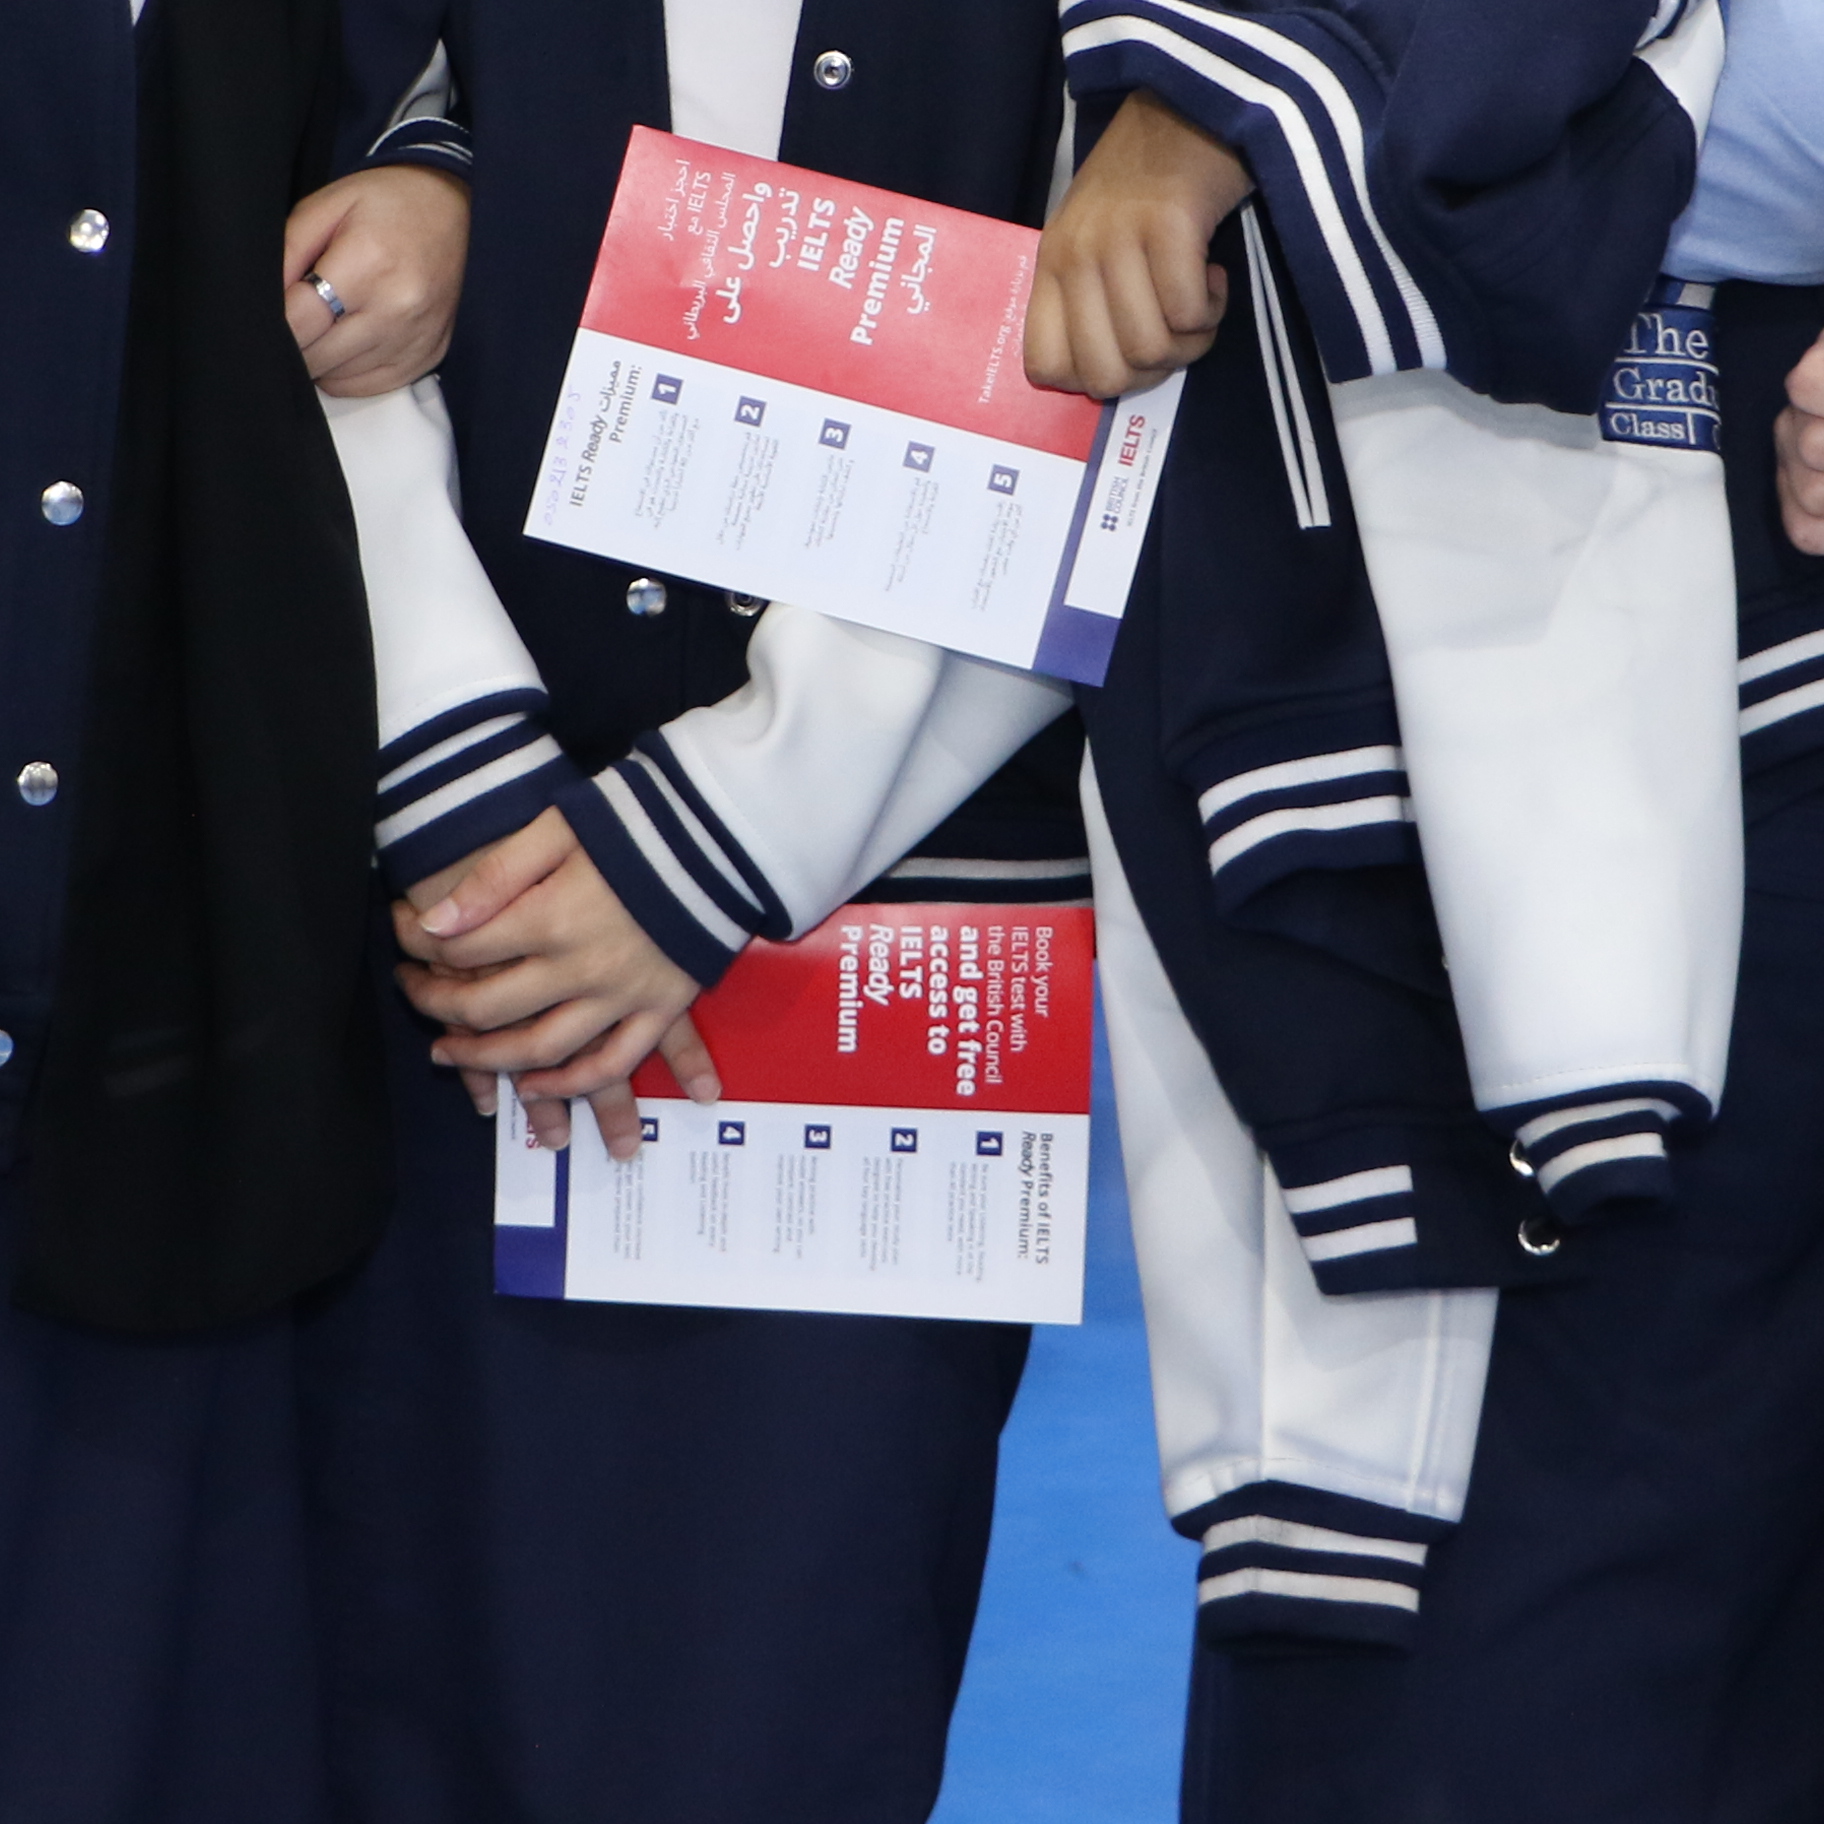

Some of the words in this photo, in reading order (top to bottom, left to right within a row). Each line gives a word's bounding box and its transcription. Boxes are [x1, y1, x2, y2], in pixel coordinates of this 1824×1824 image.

[669, 158, 691, 197] احجز
[686, 170, 711, 212] IELTS
[714, 171, 736, 228] المجلس
[656, 196, 679, 240] اختبار
[686, 215, 703, 235] مع
[727, 181, 772, 270] واحصل
[768, 186, 800, 268] تدريب
[796, 197, 835, 271] IELTS
[827, 205, 874, 289] Ready
[899, 223, 936, 314] المجاني
[715, 276, 741, 324] على
[849, 217, 904, 345] Premium
[1624, 312, 1709, 360] The
[608, 364, 642, 443] Premium:
[1609, 412, 1686, 440] Class
[568, 464, 592, 507] IELTS
[580, 413, 608, 463] Ready
[1117, 414, 1145, 467] IELTS
[1104, 475, 1120, 512] BRITISH
[1113, 477, 1129, 514] COUNCIL
[862, 923, 896, 1005] Ready
[898, 926, 924, 998] IELTS
[958, 925, 984, 979] and
[987, 925, 1005, 954] the
[1010, 926, 1028, 972] IELTS
[1034, 926, 1053, 971] Book
[837, 925, 865, 1052] Premium
[927, 925, 950, 1017] access
[986, 960, 1005, 1014] British
[1010, 977, 1027, 1009] test
[1028, 975, 1048, 1016] your
[951, 985, 980, 1032] get
[1009, 1013, 1027, 1051] with
[927, 1024, 949, 1054] to
[984, 1019, 1004, 1083] Council
[956, 1039, 982, 1095] free
[1017, 1131, 1036, 1177] Ready
[1037, 1132, 1053, 1196] Benefits
[1018, 1180, 1034, 1259] Premium:
[1037, 1202, 1051, 1218] of
[1035, 1223, 1049, 1264] IELTS
